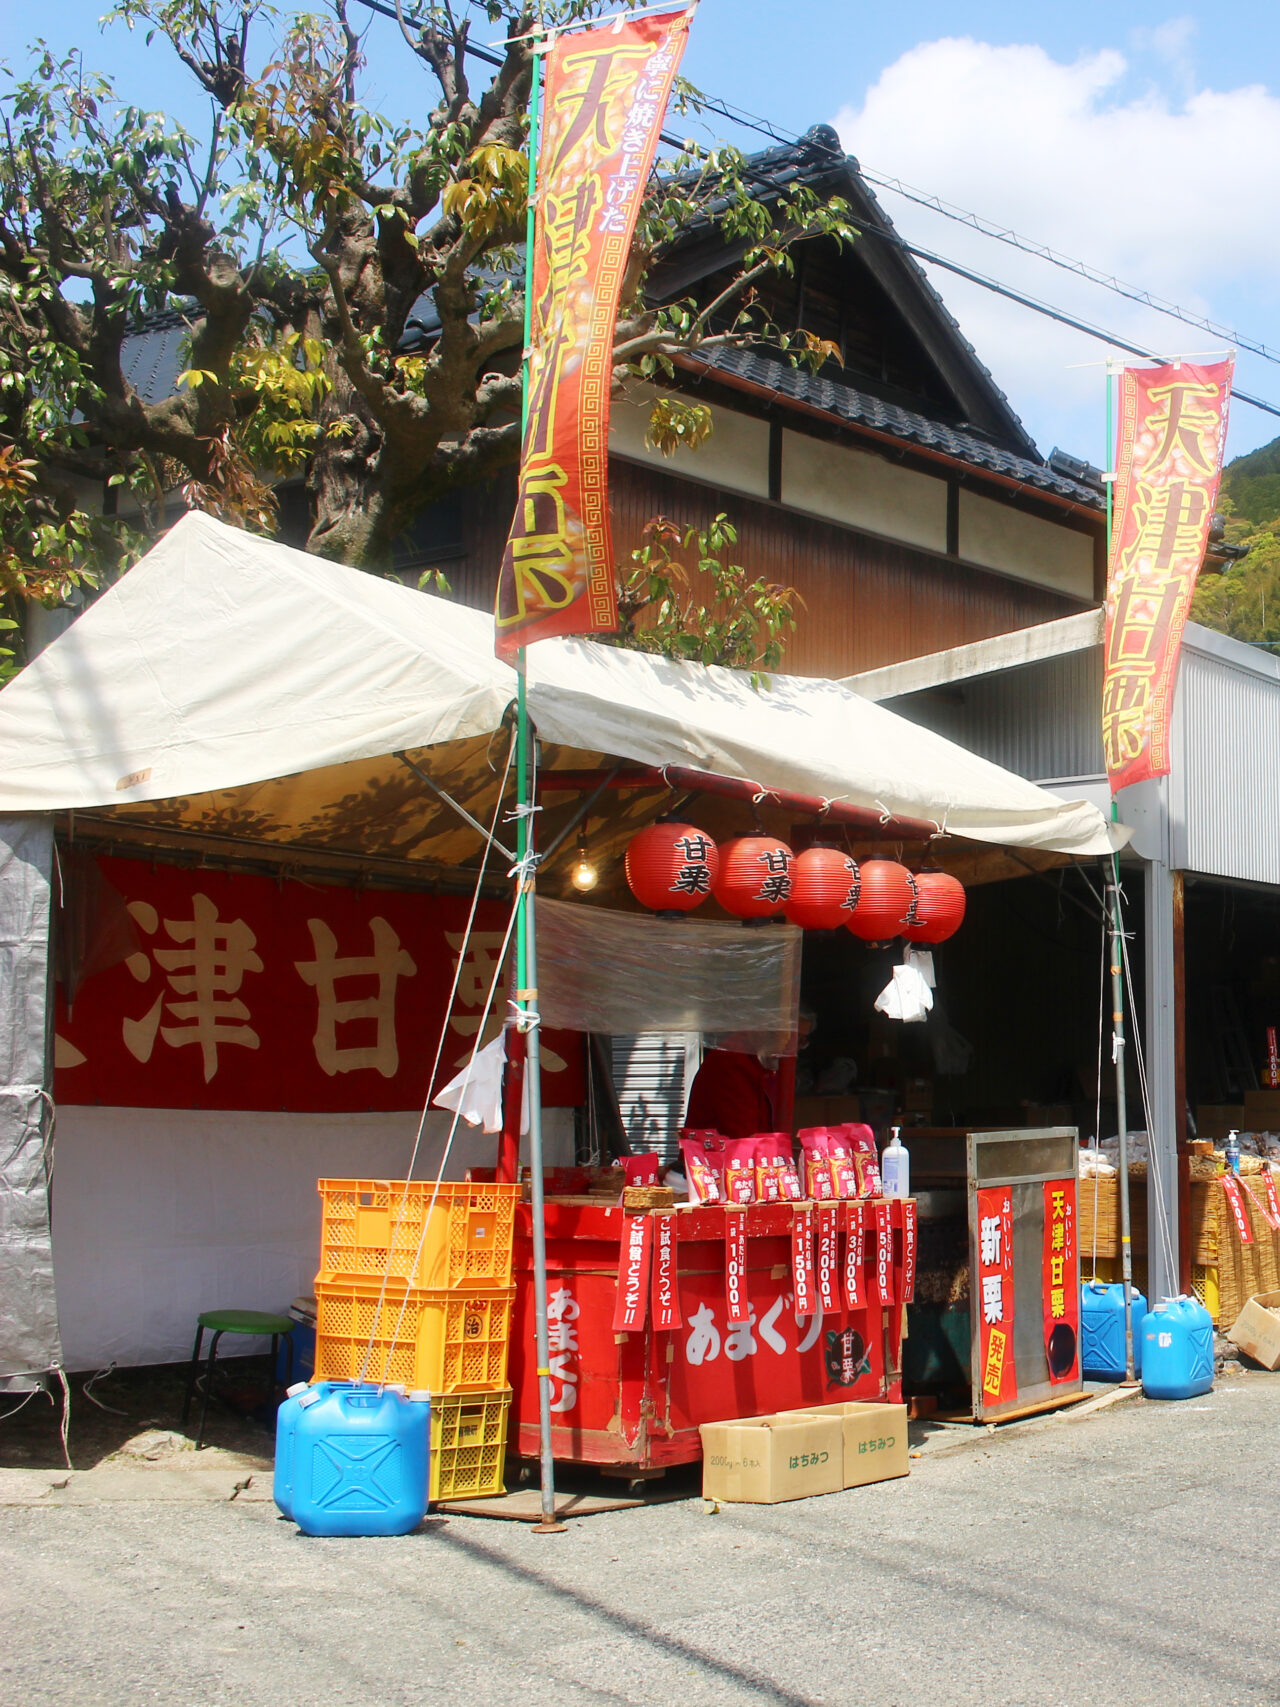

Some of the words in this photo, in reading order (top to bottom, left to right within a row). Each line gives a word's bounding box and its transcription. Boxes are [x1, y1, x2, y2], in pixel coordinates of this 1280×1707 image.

[1102, 382, 1220, 769] 天津甘栗
[669, 834, 714, 895] 甘栗
[752, 849, 792, 902] 甘栗
[55, 892, 568, 1084] 津甘
[980, 1216, 1003, 1325] 新栗
[1002, 1196, 1012, 1271] おいしい
[1050, 1190, 1066, 1319] 天津甘栗
[728, 1243, 740, 1317] 1,000円
[686, 1291, 823, 1366] あまぐり
[841, 1332, 855, 1385] 甘栗
[985, 1333, 1004, 1391] 発売
[789, 1452, 829, 1469] はちみつ
[858, 1437, 896, 1454] はちみつ
